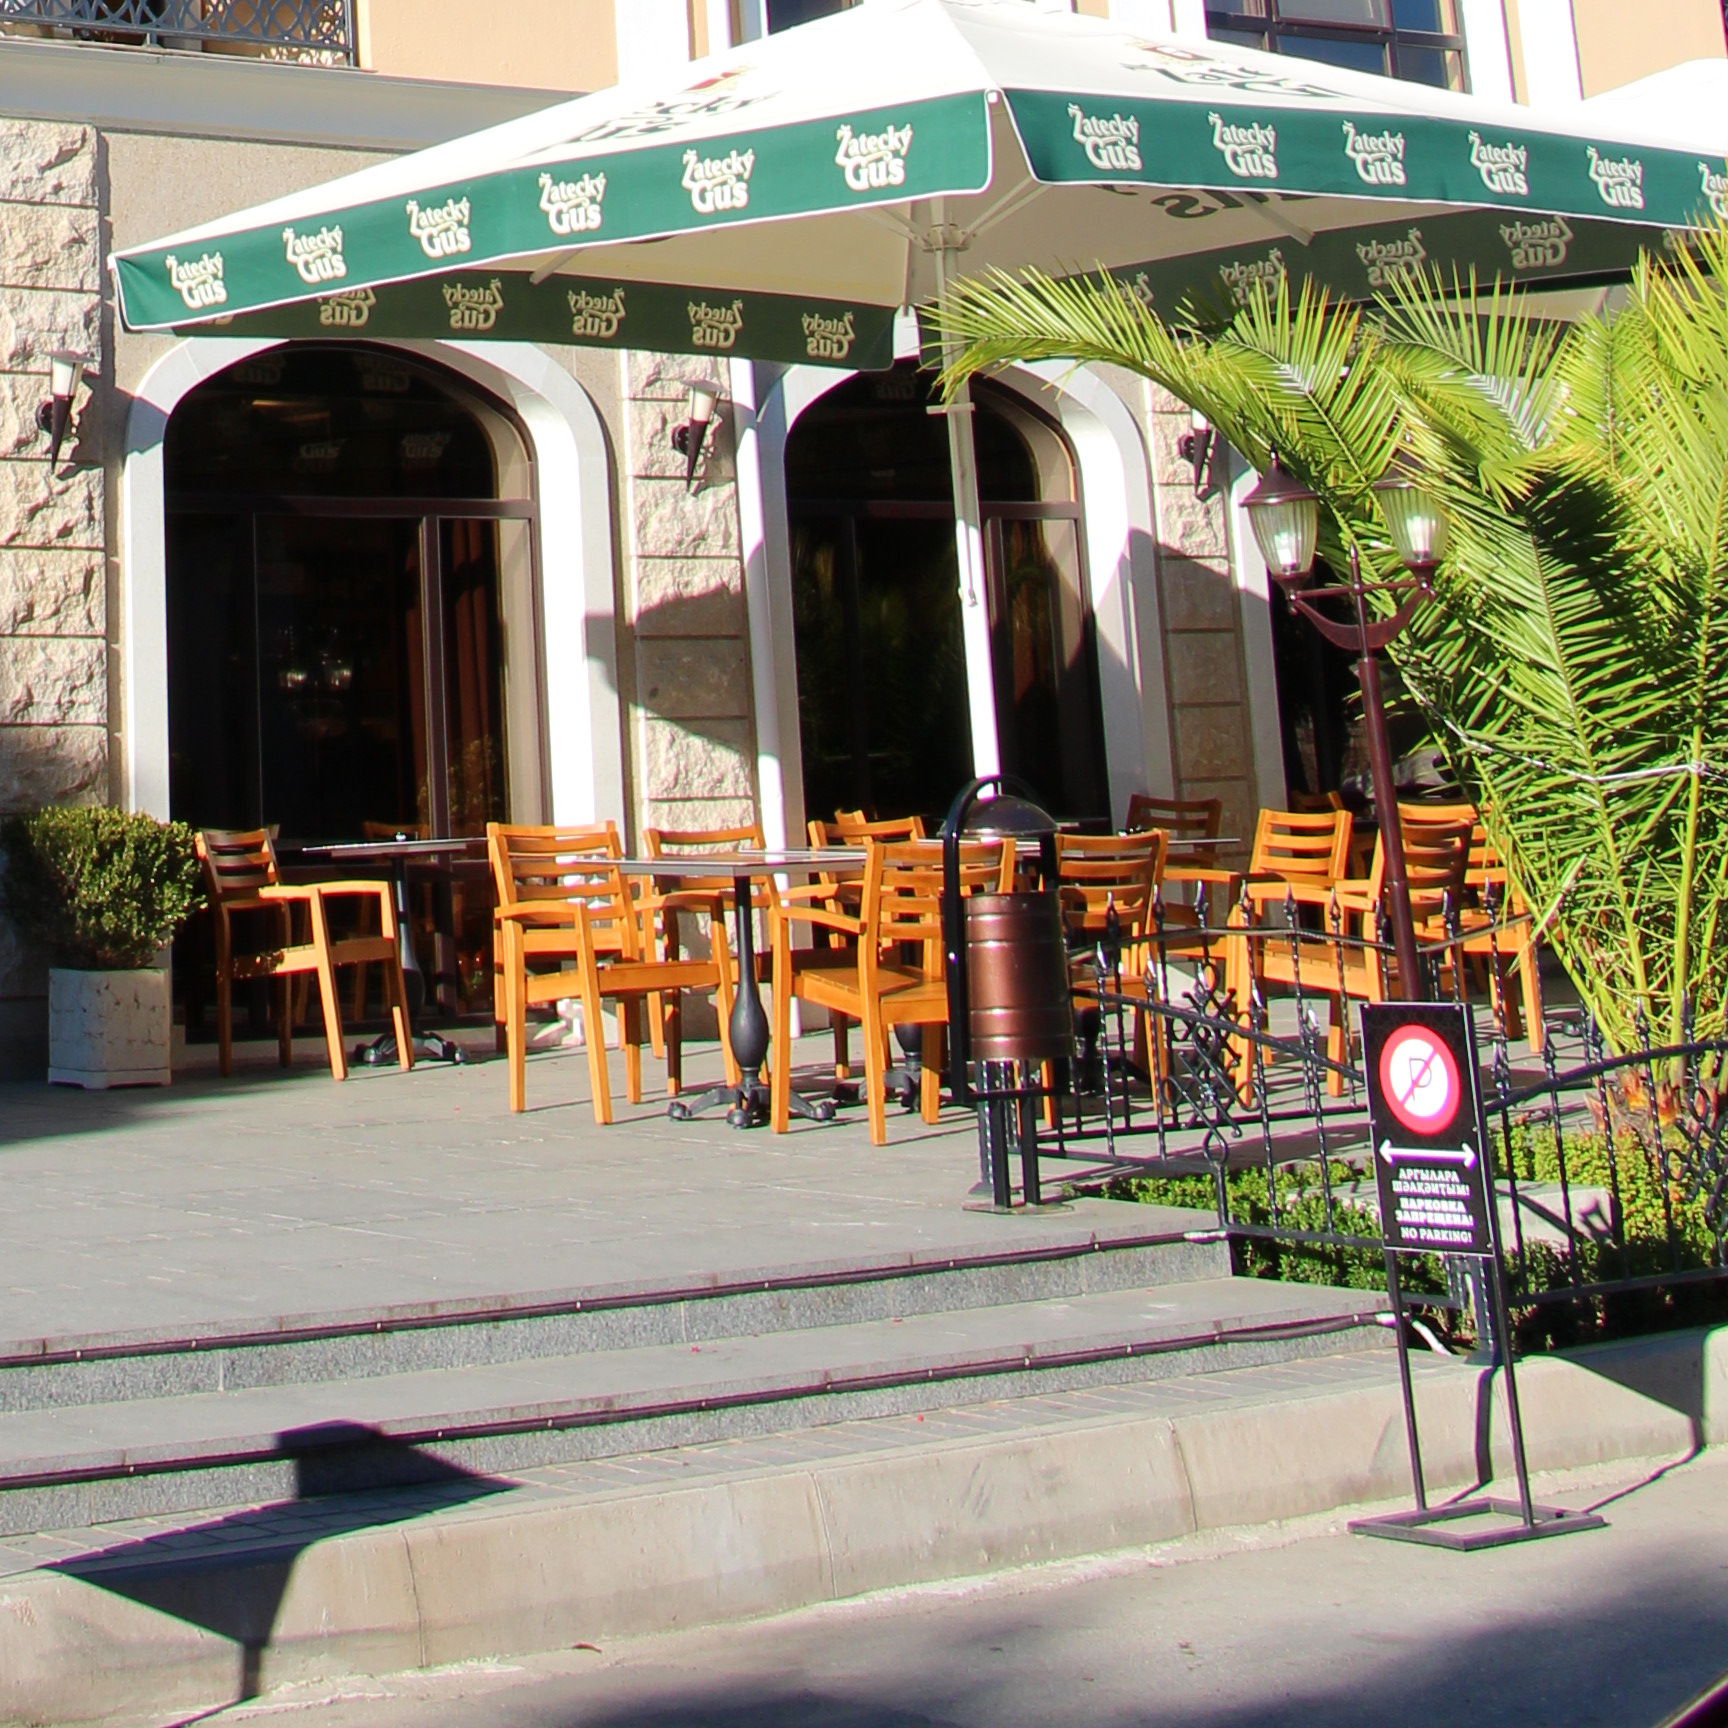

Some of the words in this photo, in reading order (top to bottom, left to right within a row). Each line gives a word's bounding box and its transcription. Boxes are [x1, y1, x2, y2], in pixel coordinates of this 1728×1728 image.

[1068, 102, 1140, 145] Žatecký
[1208, 110, 1276, 153] Žatecký
[1342, 120, 1405, 161] Žatecký
[835, 124, 913, 167] Žatecký
[1085, 136, 1143, 171] Gus
[1225, 144, 1278, 178] Gus
[1468, 129, 1527, 172] Žatecký
[682, 148, 755, 191] Žatecký
[845, 151, 906, 191] Gus
[1355, 153, 1407, 186] Gus
[1480, 162, 1529, 196] Gus
[1585, 145, 1643, 186] Žatecký
[538, 172, 607, 212] Žatecký
[691, 175, 749, 214] Gus
[1598, 176, 1646, 210] Gus
[406, 197, 471, 237] Žatecký
[549, 197, 602, 235] Gus
[283, 225, 344, 264] Žatecký
[420, 221, 472, 258] Gus
[165, 252, 223, 290] Žatecký
[297, 248, 347, 284] Gus
[181, 274, 228, 310] Gus
[1394, 1209, 1474, 1227] ЗАПРЕЩЕНА!
[1399, 1197, 1468, 1214] ПАРКОВКА
[1400, 1226, 1418, 1239] NO
[1418, 1228, 1473, 1244] PARKING!
